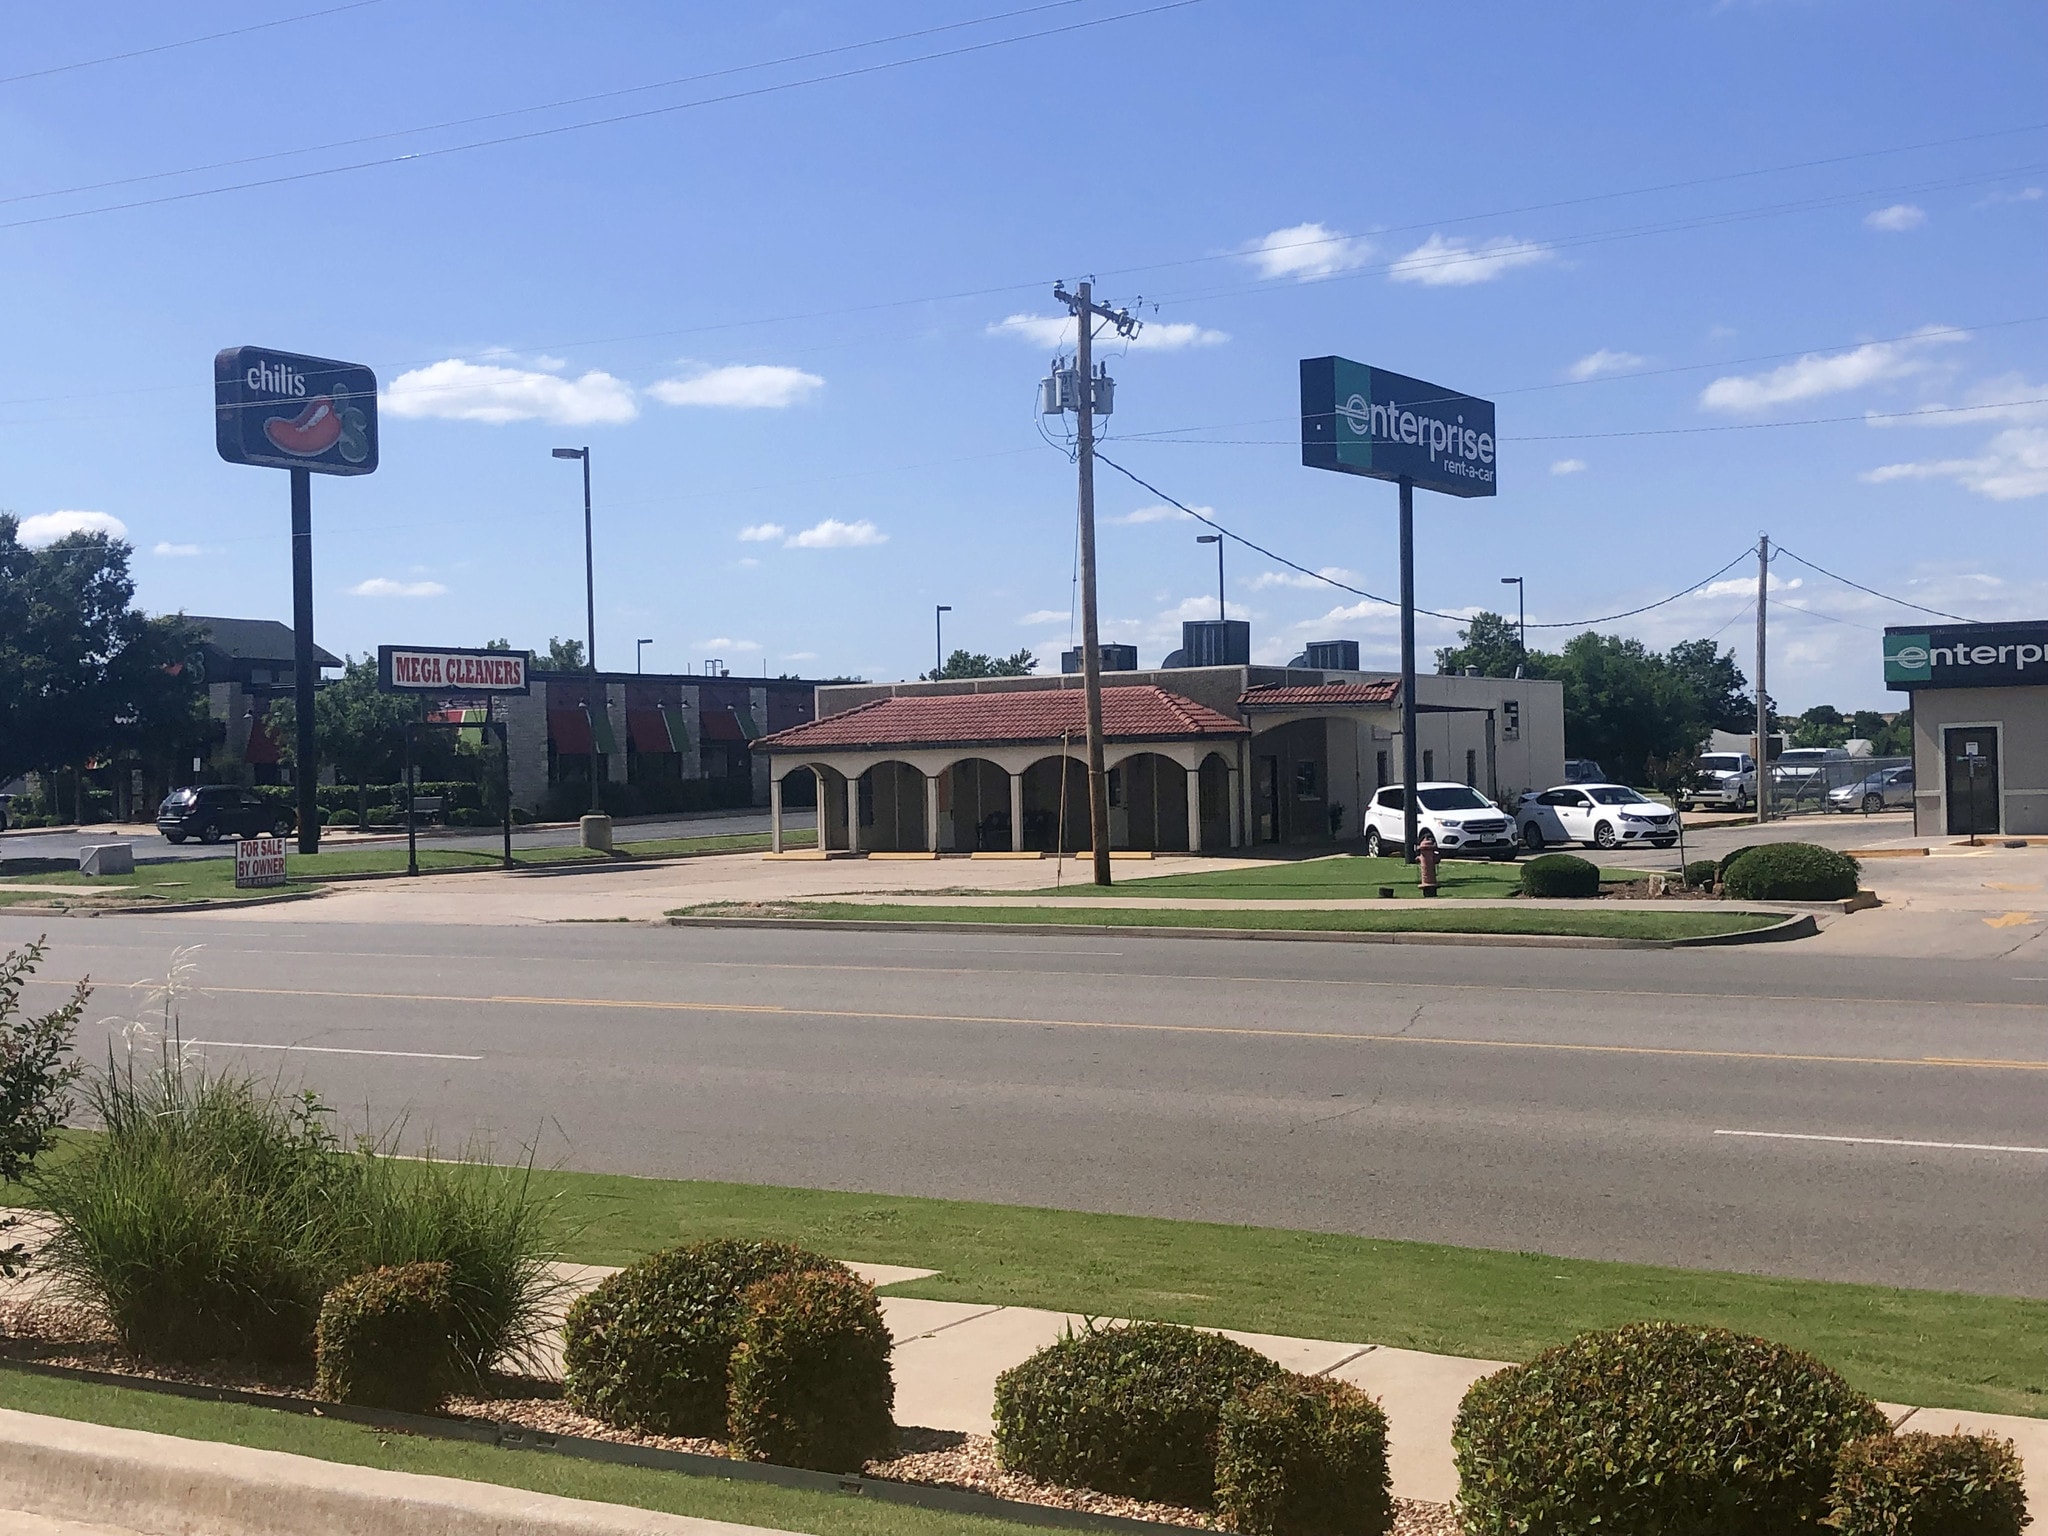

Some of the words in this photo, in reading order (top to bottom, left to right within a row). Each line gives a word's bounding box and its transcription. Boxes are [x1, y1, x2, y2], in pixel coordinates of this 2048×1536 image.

[247, 360, 306, 396] chilis
[1335, 394, 1494, 464] enterprise
[1443, 459, 1494, 482] rent-a-car
[396, 657, 442, 683] MEGA
[446, 658, 521, 685] CLEANERS
[241, 841, 259, 858] FOR
[261, 839, 283, 856] SALE
[238, 860, 250, 877] BY
[252, 858, 285, 876] OWNER
